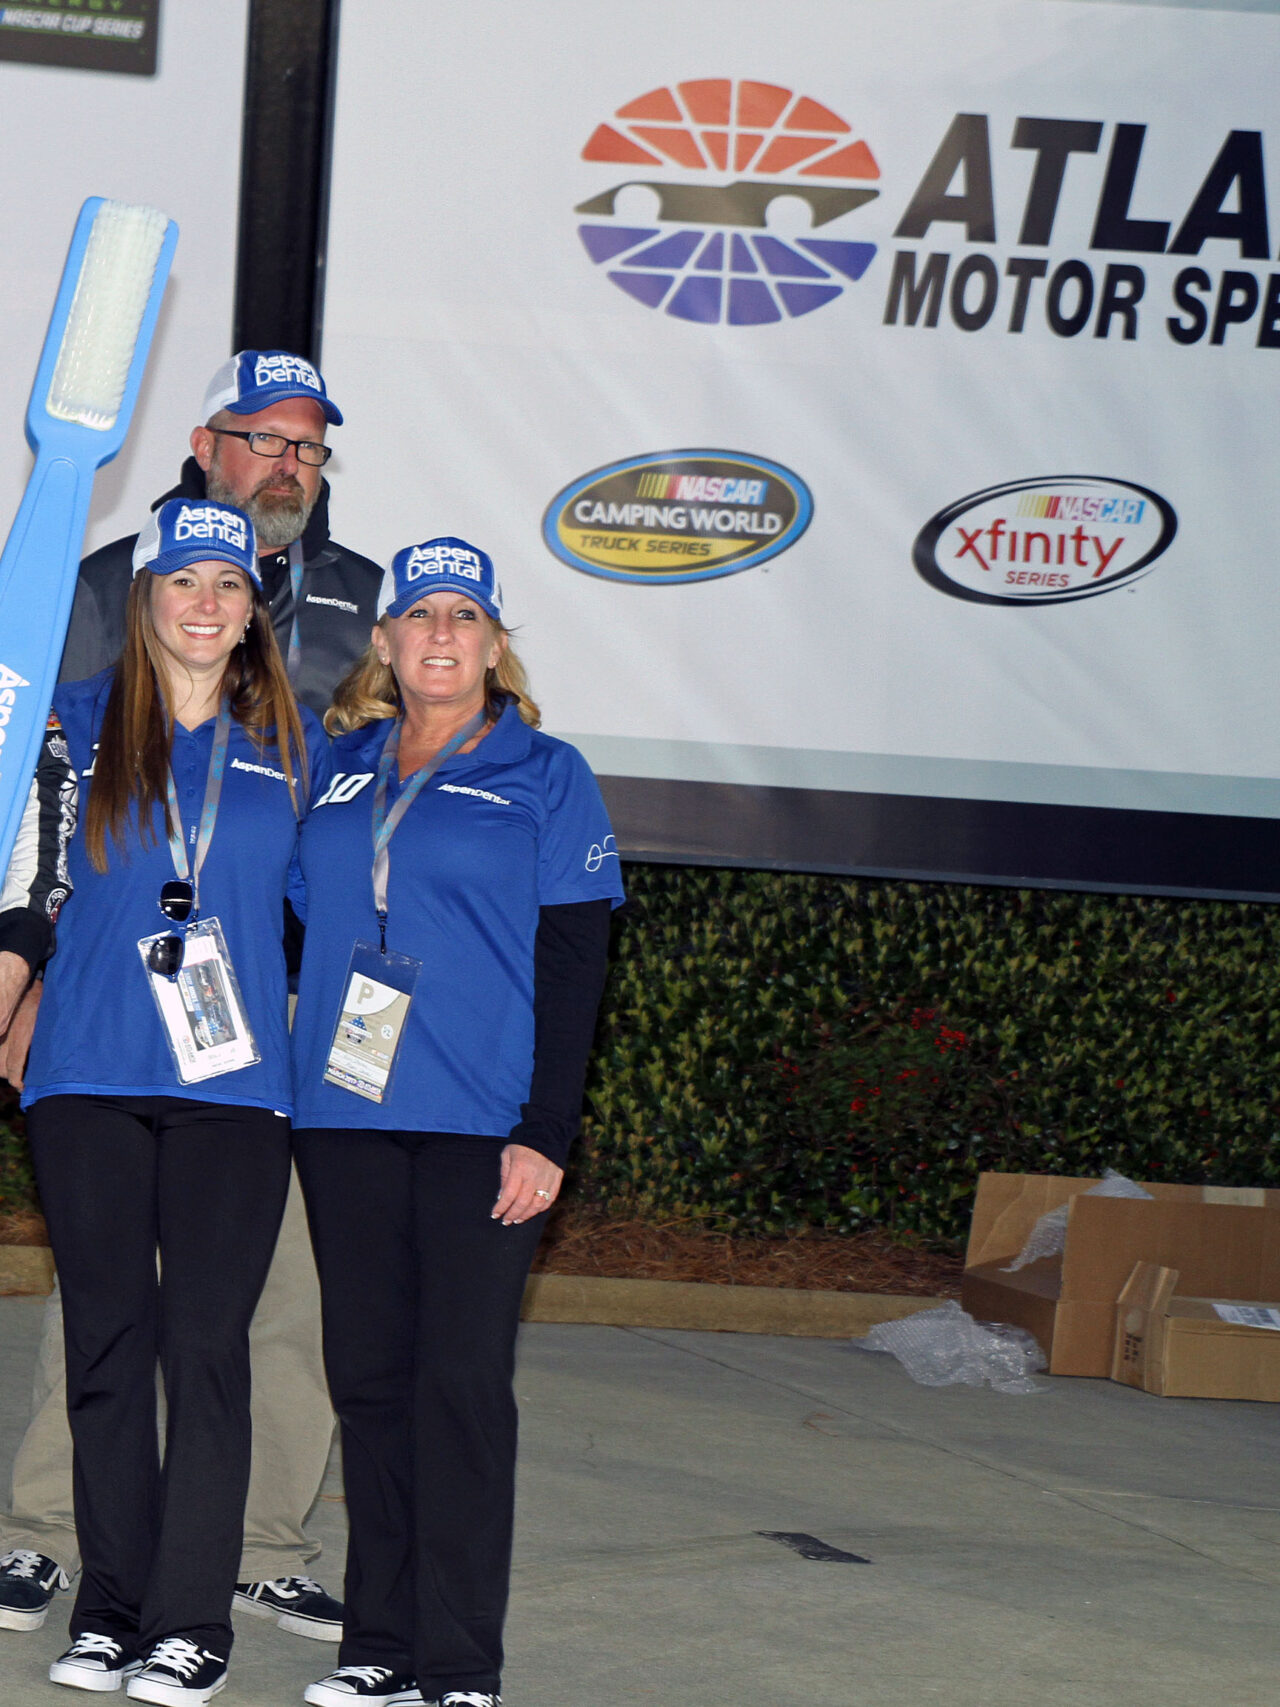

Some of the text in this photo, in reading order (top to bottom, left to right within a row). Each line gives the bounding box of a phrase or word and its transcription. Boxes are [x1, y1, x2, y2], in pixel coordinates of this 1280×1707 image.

[891, 112, 1280, 261] ATLA
[881, 250, 1146, 342] MOTOR
[255, 355, 318, 375] Aspen
[256, 367, 321, 393] Dental
[675, 475, 762, 505] NASCAR
[176, 506, 246, 532] Aspen
[574, 499, 783, 535] CAMPING WORLD
[1057, 497, 1140, 525] NASCAR
[175, 522, 248, 551] Dental
[580, 534, 713, 558] TRUCK SERIES
[954, 518, 1126, 579] xfinity
[407, 545, 479, 567] Aspen
[407, 557, 482, 583] Dental
[1004, 570, 1070, 588] SERIES
[312, 773, 375, 810] 10
[356, 981, 375, 1005] P
